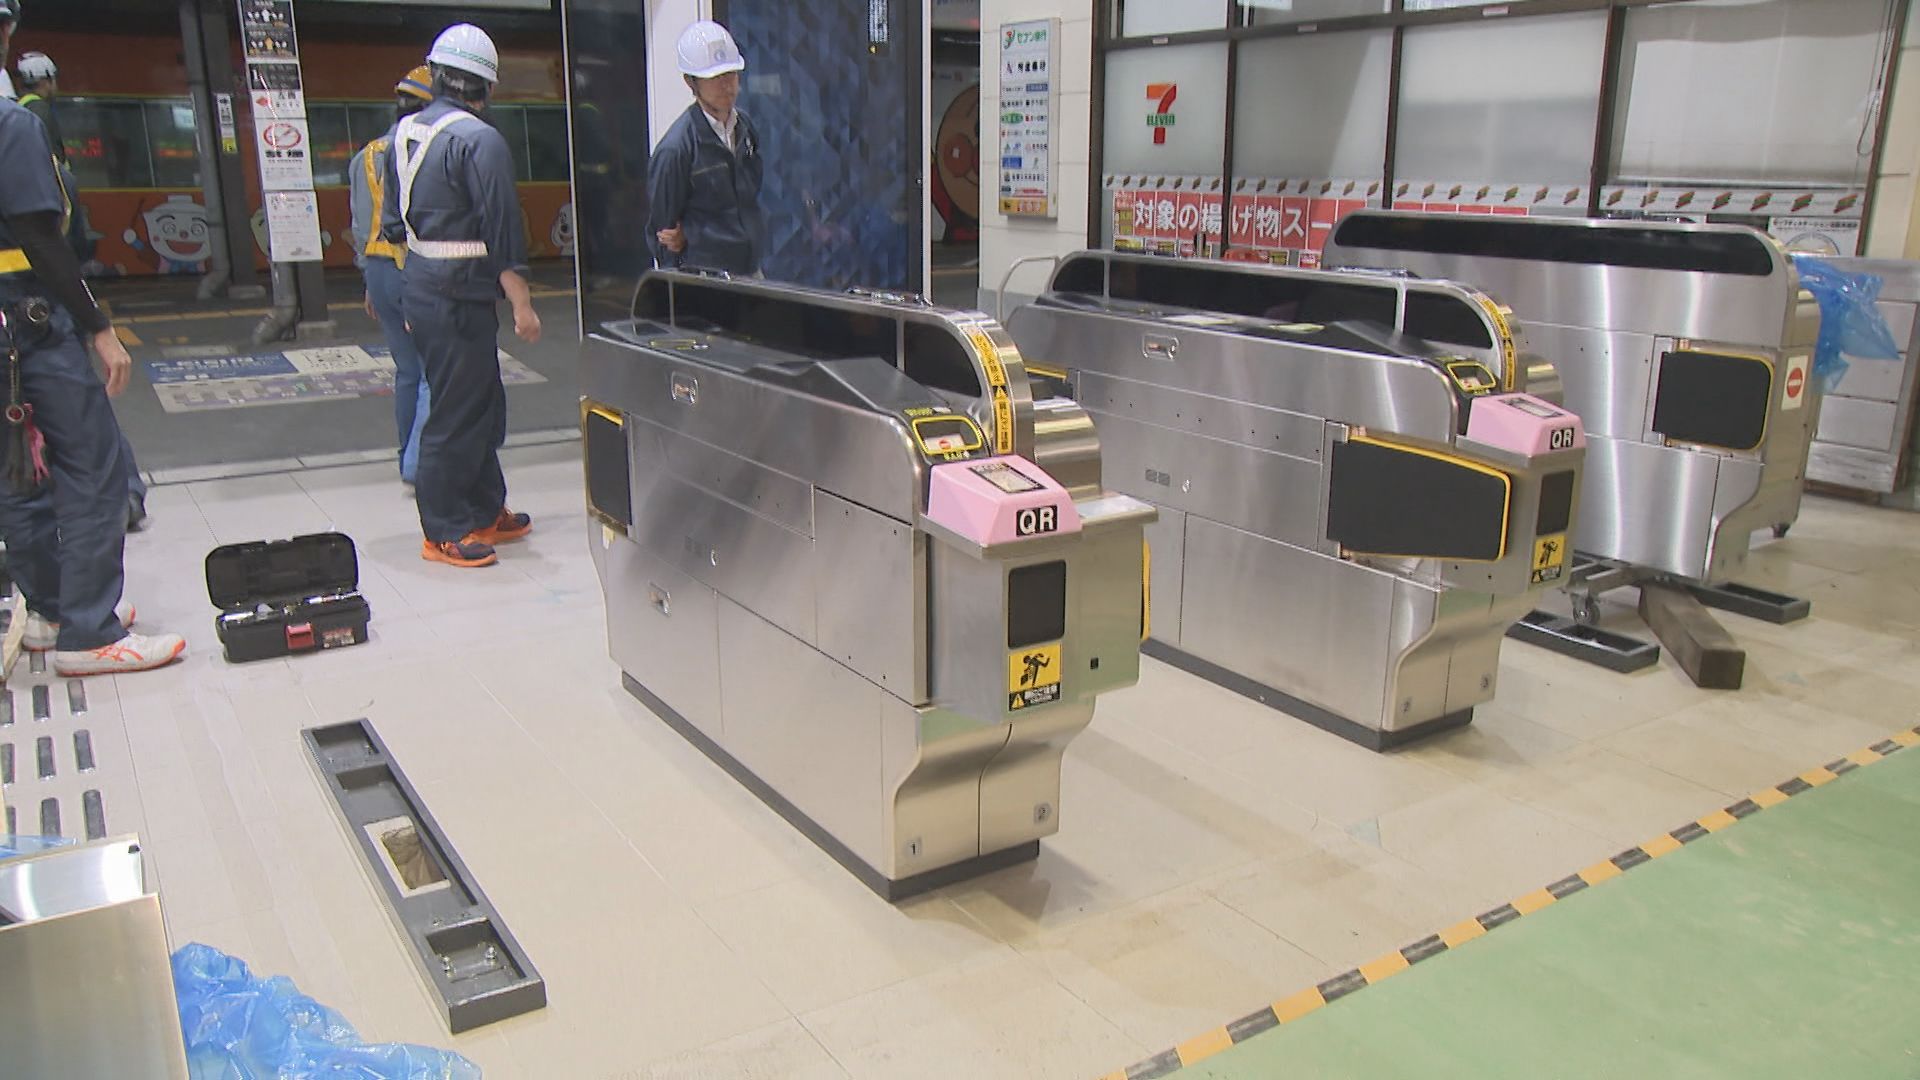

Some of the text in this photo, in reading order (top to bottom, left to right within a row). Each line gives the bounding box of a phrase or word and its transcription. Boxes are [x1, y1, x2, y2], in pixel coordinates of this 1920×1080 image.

[1147, 84, 1176, 144] 7
[1552, 429, 1573, 449] QR
[1019, 508, 1055, 535] QR
